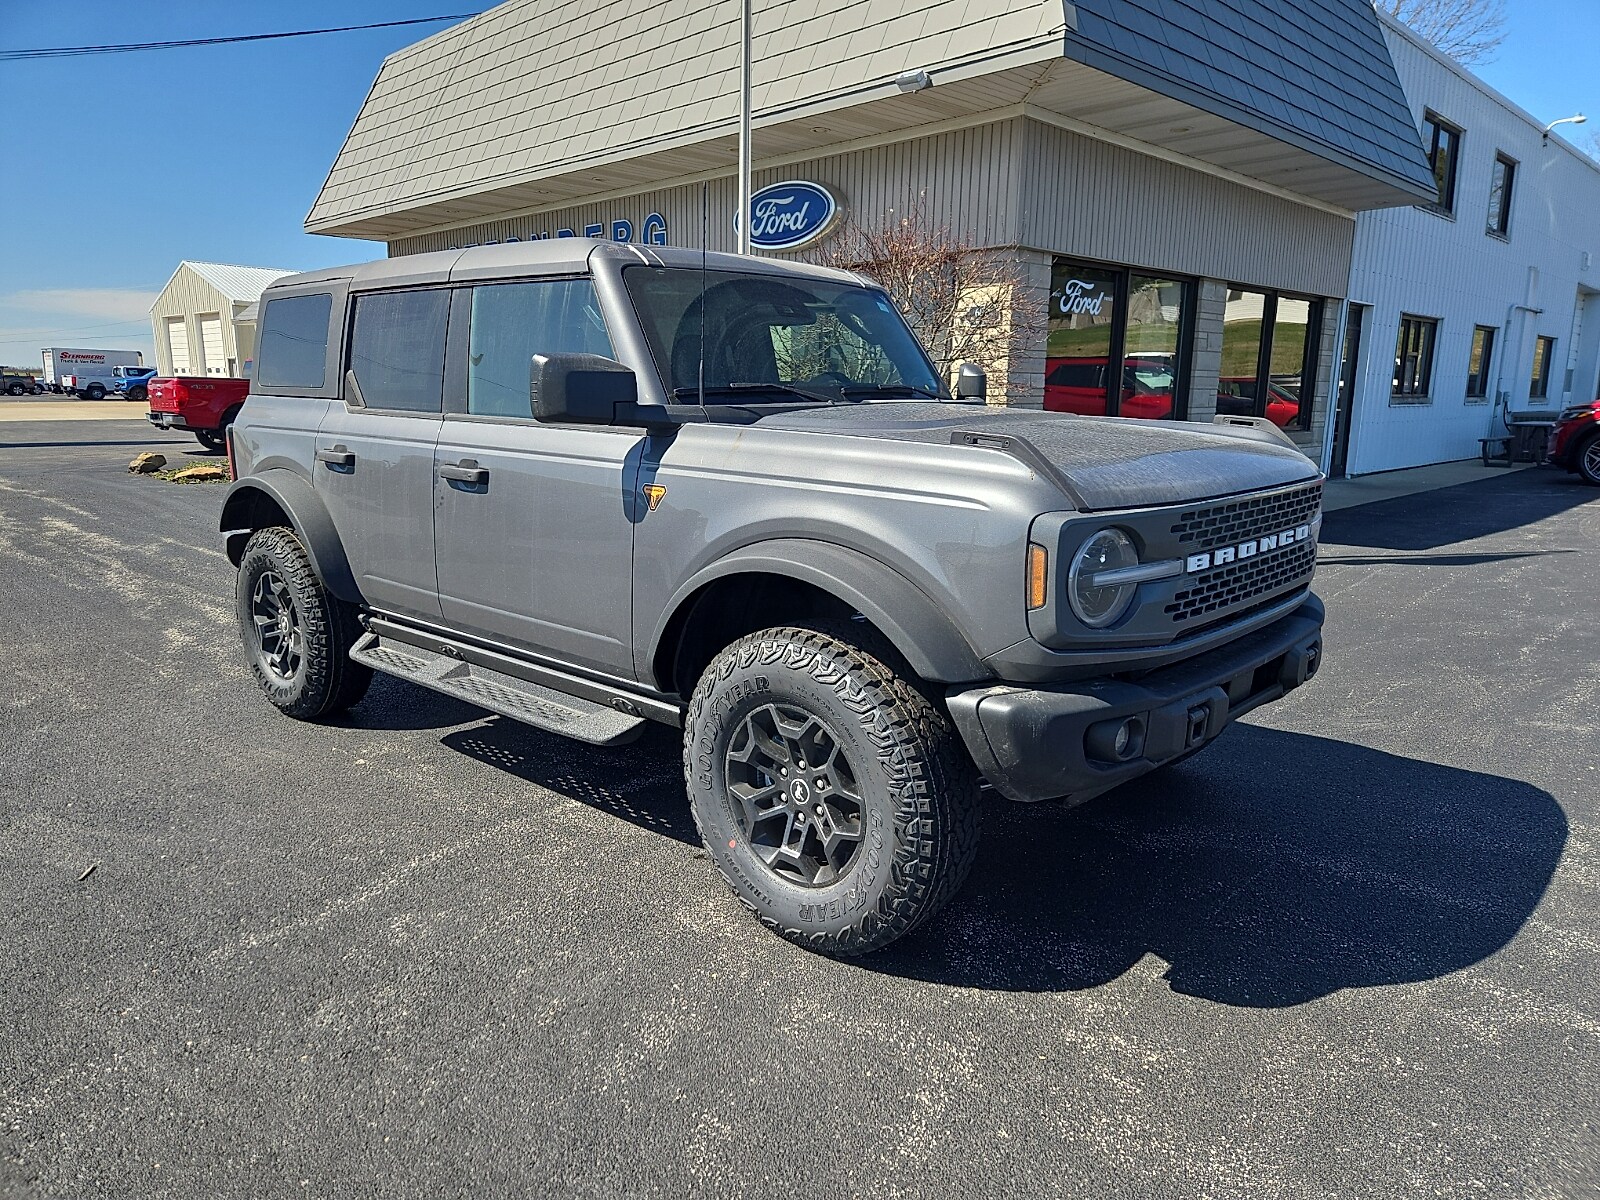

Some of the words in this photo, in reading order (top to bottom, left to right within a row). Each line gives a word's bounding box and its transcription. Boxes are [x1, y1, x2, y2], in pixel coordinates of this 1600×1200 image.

[751, 196, 810, 237] Ford
[1060, 280, 1105, 316] Ford
[1187, 524, 1309, 573] BRONCO
[698, 675, 771, 791] GOODYEAR
[798, 808, 883, 923] GOODYEAR
